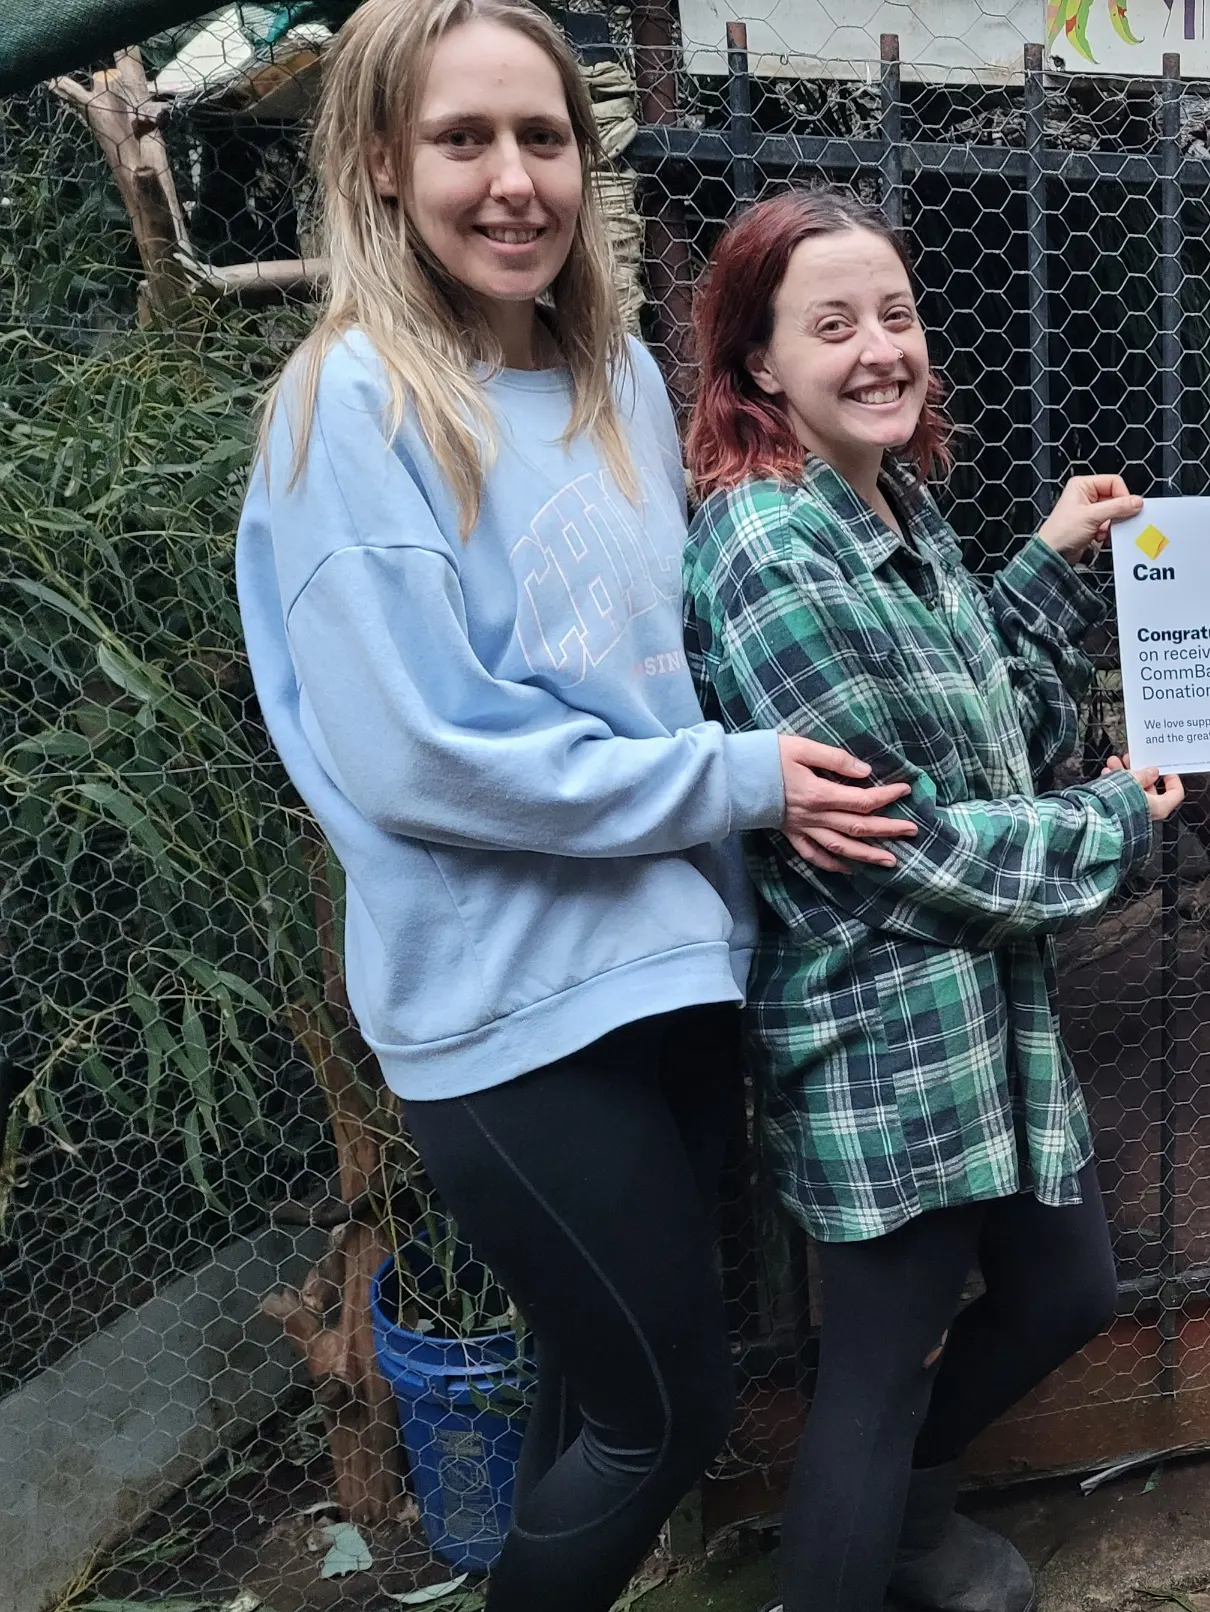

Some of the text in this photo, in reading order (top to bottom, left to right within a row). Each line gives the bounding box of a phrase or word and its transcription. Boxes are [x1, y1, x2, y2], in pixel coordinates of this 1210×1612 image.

[1133, 563, 1175, 581] Can
[1139, 650, 1159, 662] on
[1144, 720, 1161, 729] We
[1164, 719, 1184, 728] love
[1146, 733, 1165, 744] and
[1166, 733, 1184, 742] the
